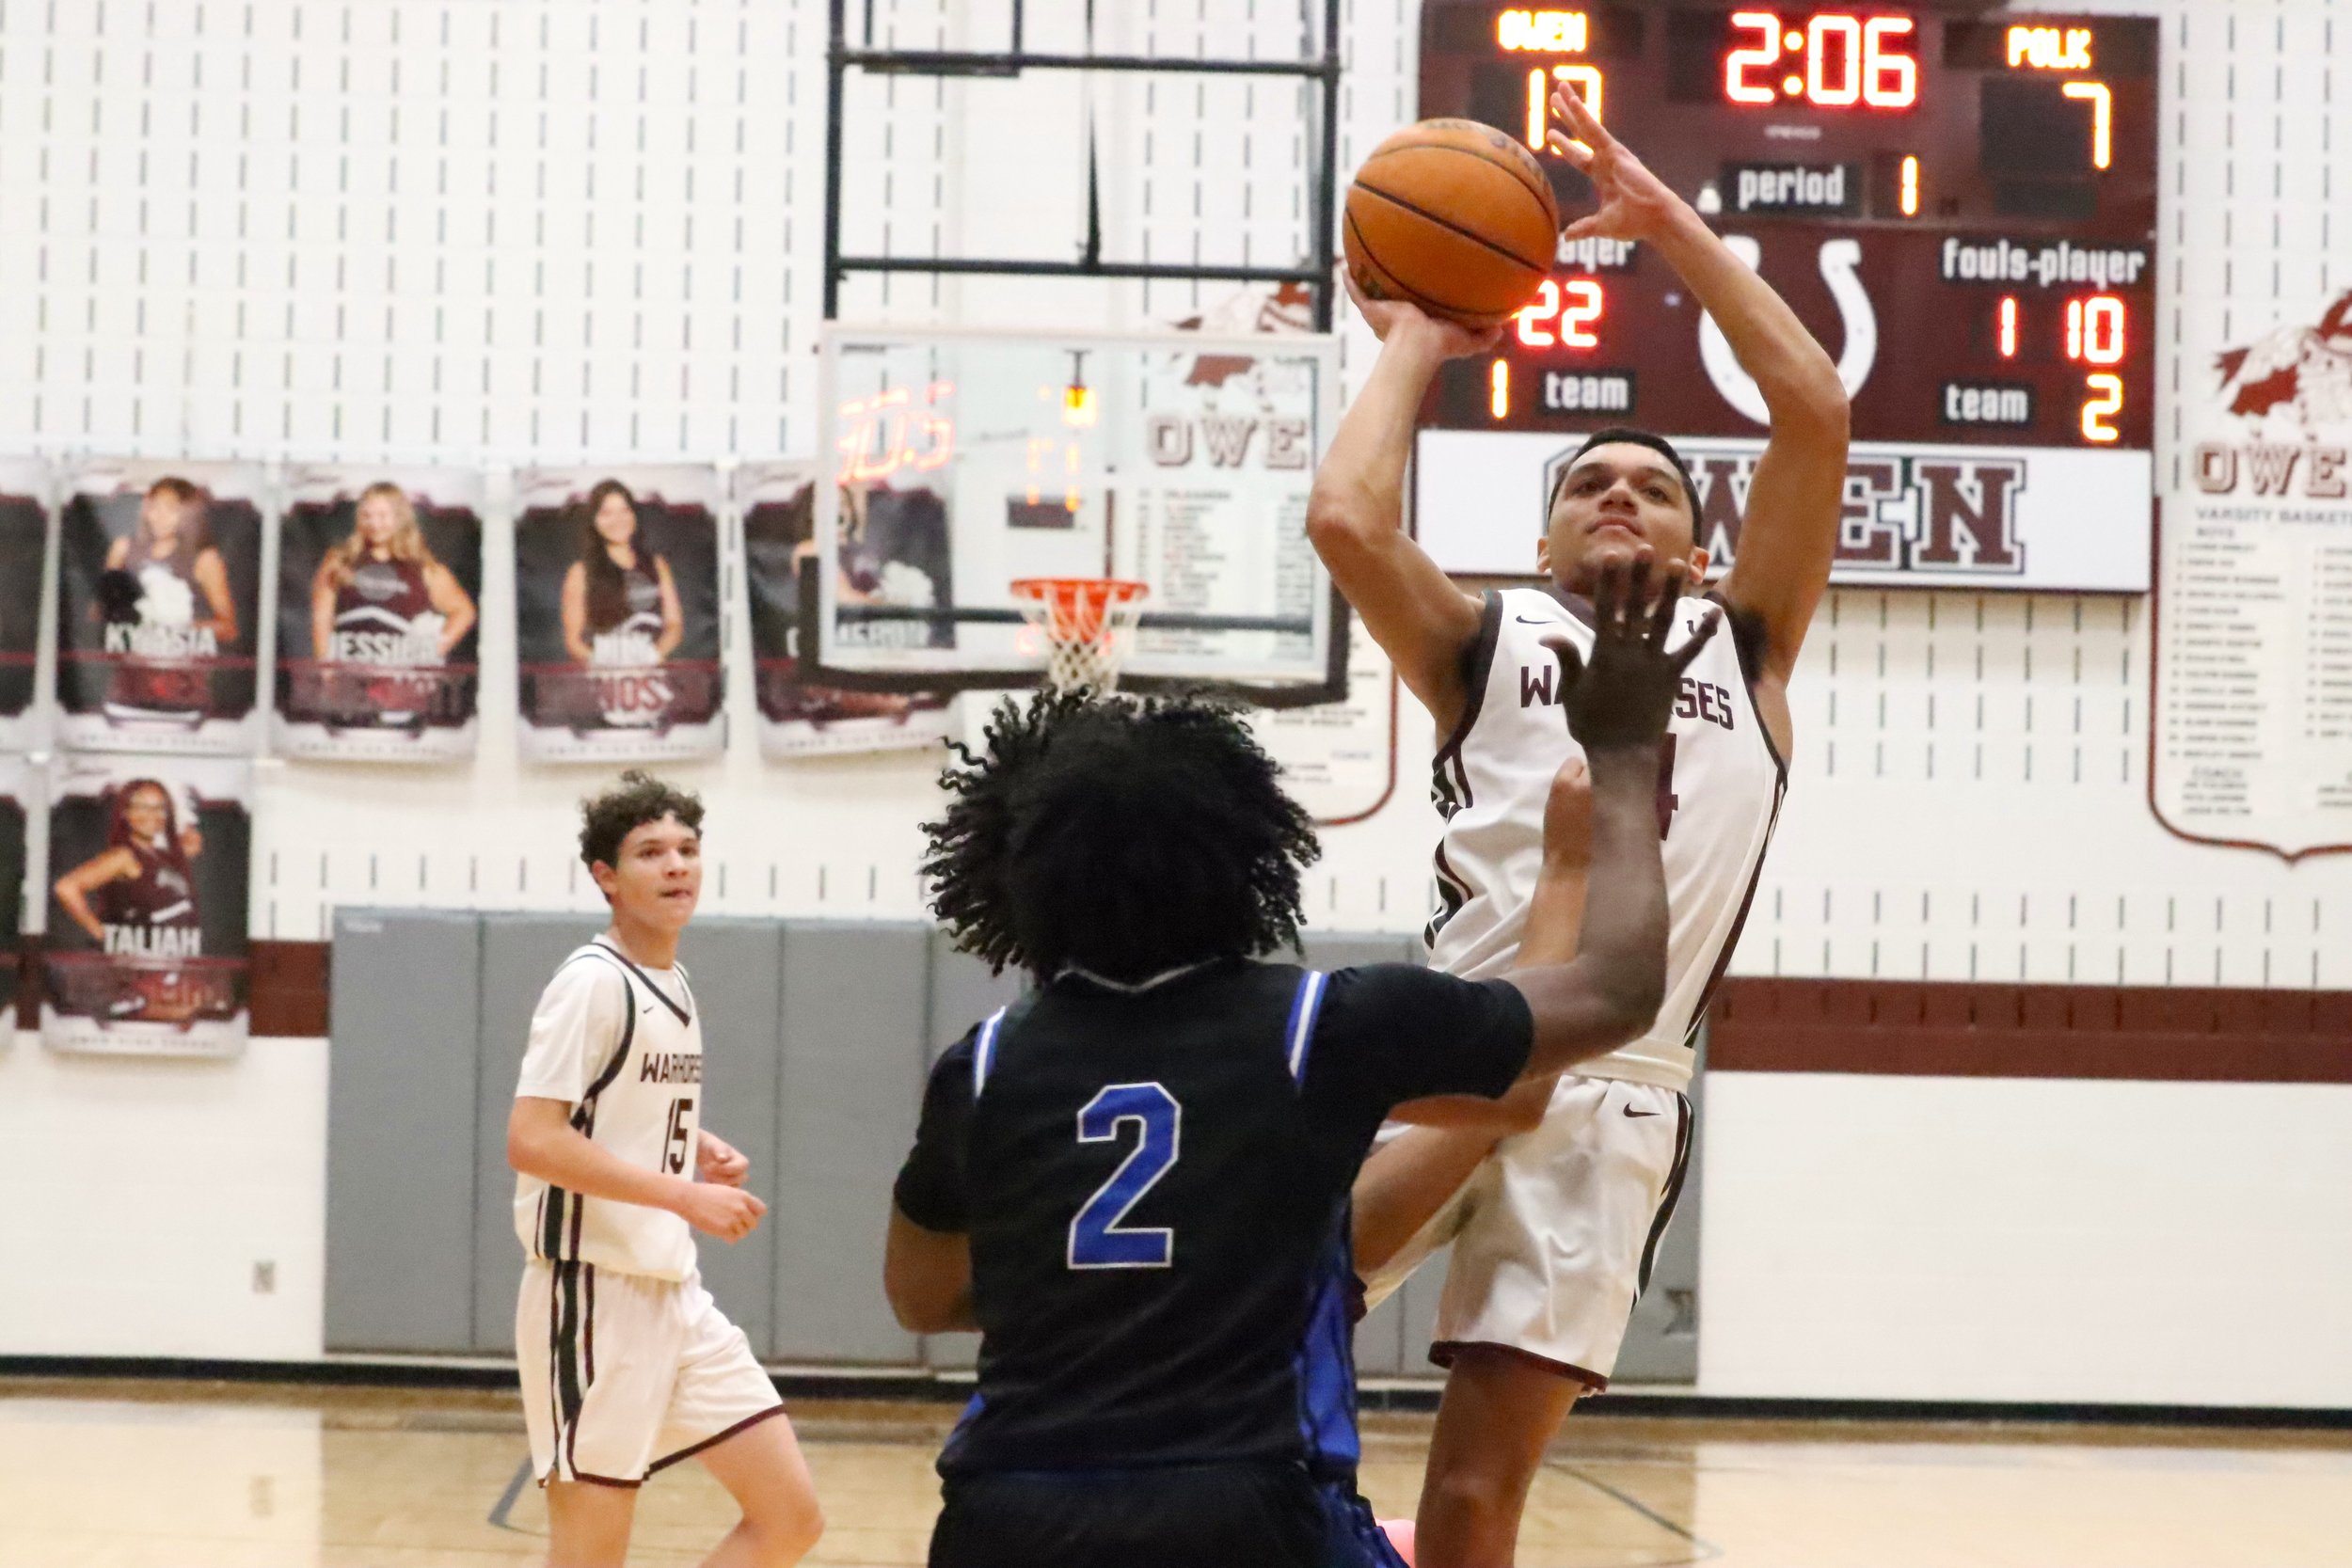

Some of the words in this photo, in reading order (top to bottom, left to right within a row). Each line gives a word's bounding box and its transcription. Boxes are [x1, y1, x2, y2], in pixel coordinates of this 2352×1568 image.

[1498, 9, 1588, 53] OWEN
[1725, 11, 1917, 108] 2:06
[2007, 25, 2092, 70] POLK
[2061, 81, 2111, 169] 7
[1738, 165, 1845, 212] period
[1901, 155, 1918, 215] 1
[1943, 237, 2146, 291] fouls-player
[1517, 278, 1603, 348] 22
[2067, 295, 2125, 364] 10
[1491, 359, 1509, 419] 1
[1545, 372, 1629, 409] team
[1946, 384, 2028, 423] team
[2081, 373, 2123, 441] 2
[2279, 509, 2352, 524] BASKET
[660, 1098, 693, 1175] 15
[1067, 1081, 1181, 1270] 2
